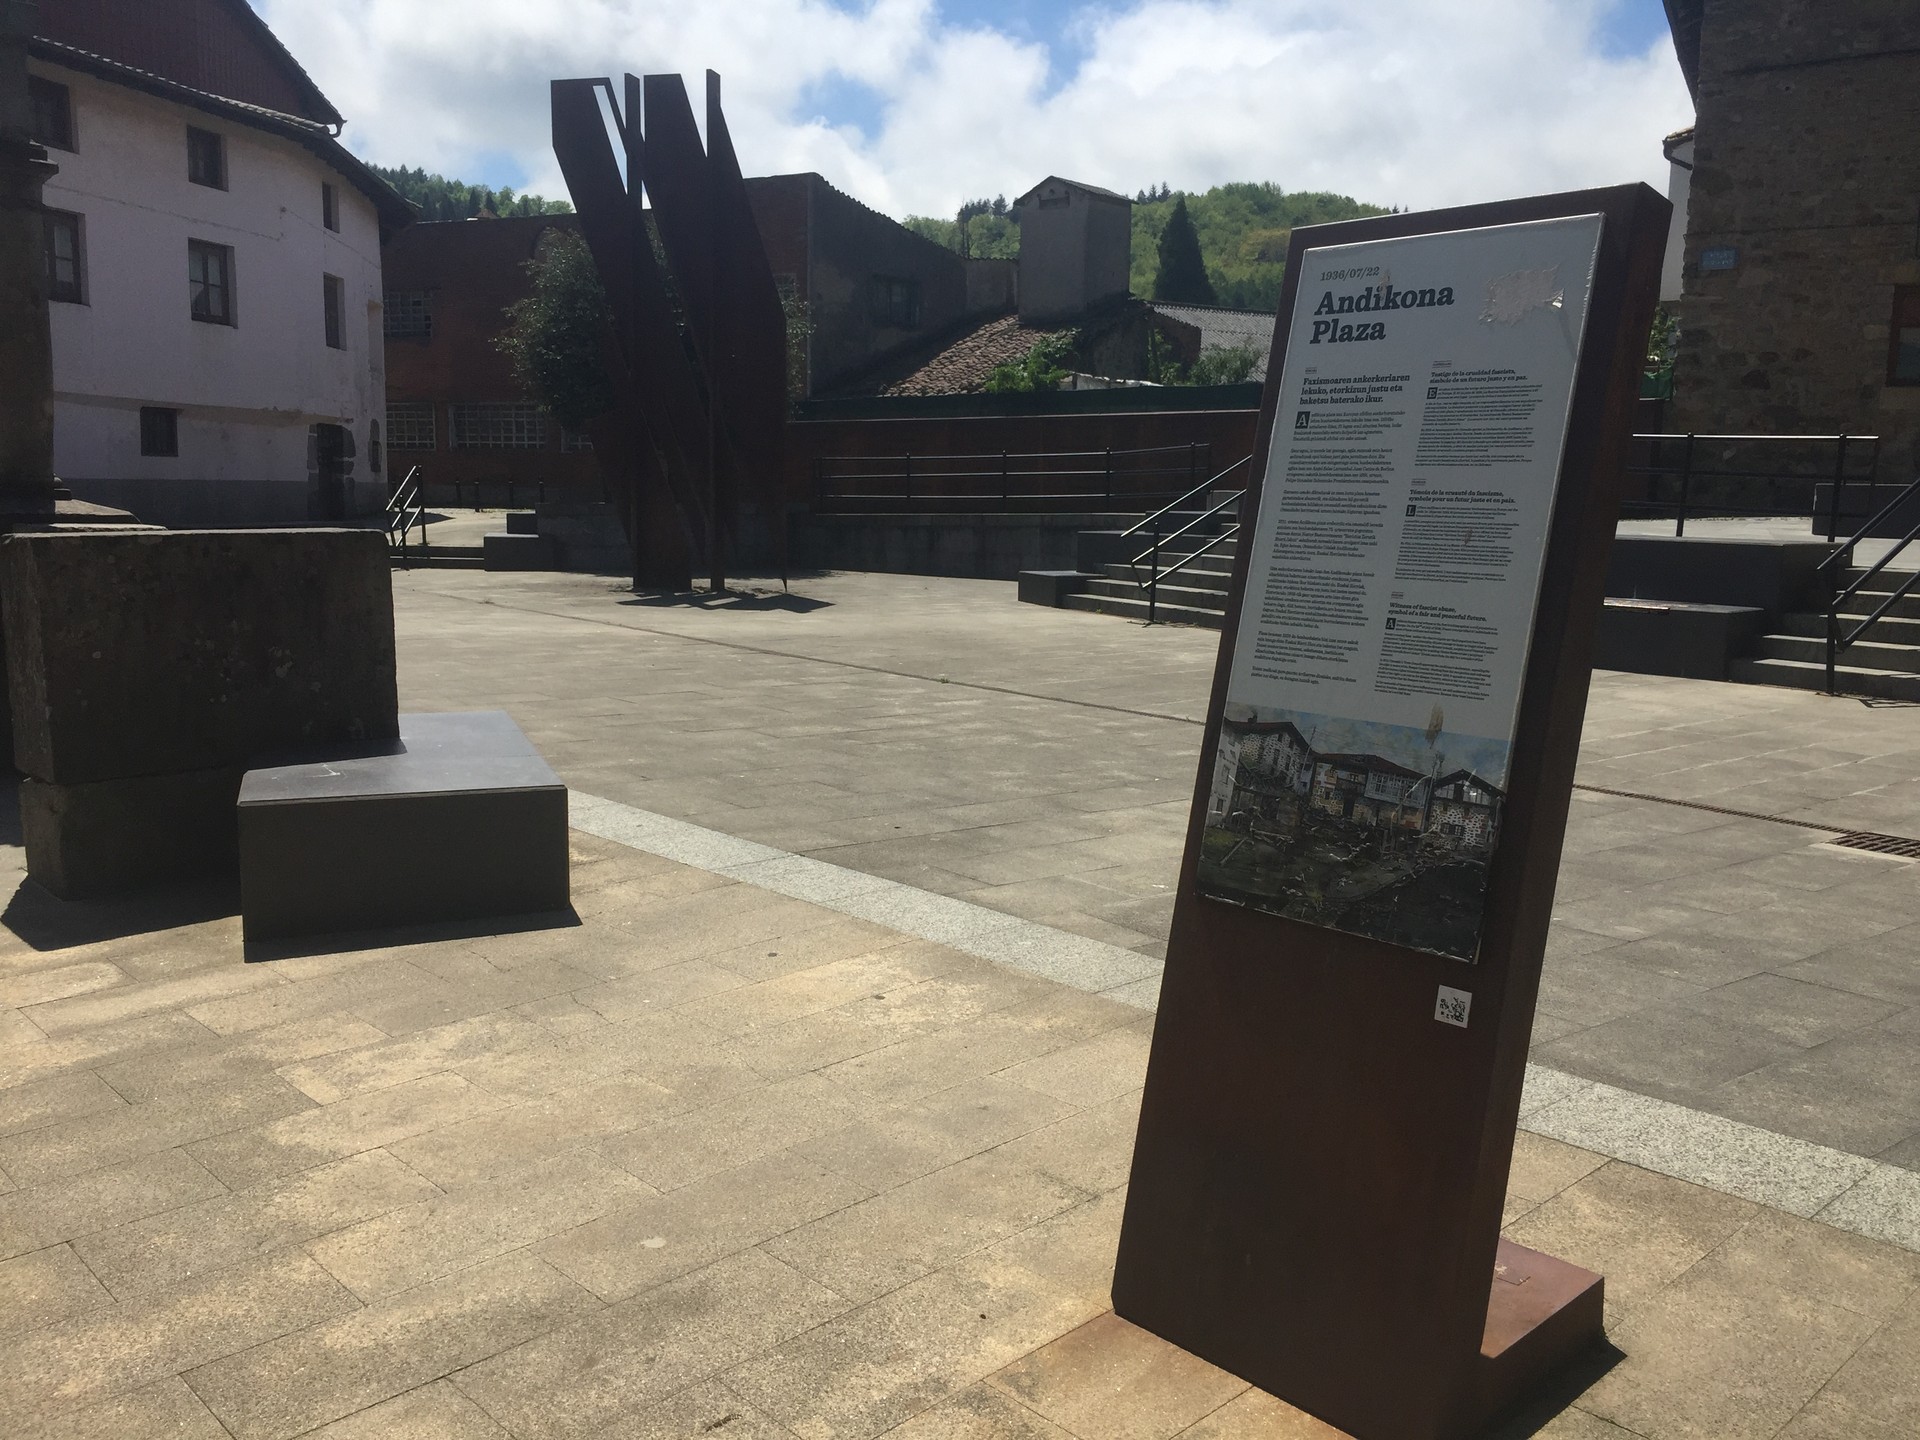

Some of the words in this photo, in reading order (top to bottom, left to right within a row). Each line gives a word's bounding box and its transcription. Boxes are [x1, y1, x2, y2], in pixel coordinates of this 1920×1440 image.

[1320, 267, 1379, 281] 1936/07/22
[1314, 285, 1455, 315] Andikona
[1310, 318, 1386, 344] Plaza
[1303, 376, 1352, 386] Faxismoaren
[1352, 373, 1411, 384] ankerkeriaren
[1300, 386, 1329, 396] lekuko,
[1328, 385, 1367, 395] etorkizun
[1366, 384, 1389, 395] justu
[1389, 384, 1403, 393] eta
[1299, 396, 1329, 406] baketsu
[1329, 394, 1365, 404] baterako
[1364, 394, 1384, 403] ikur.
[1387, 608, 1409, 616] symbol
